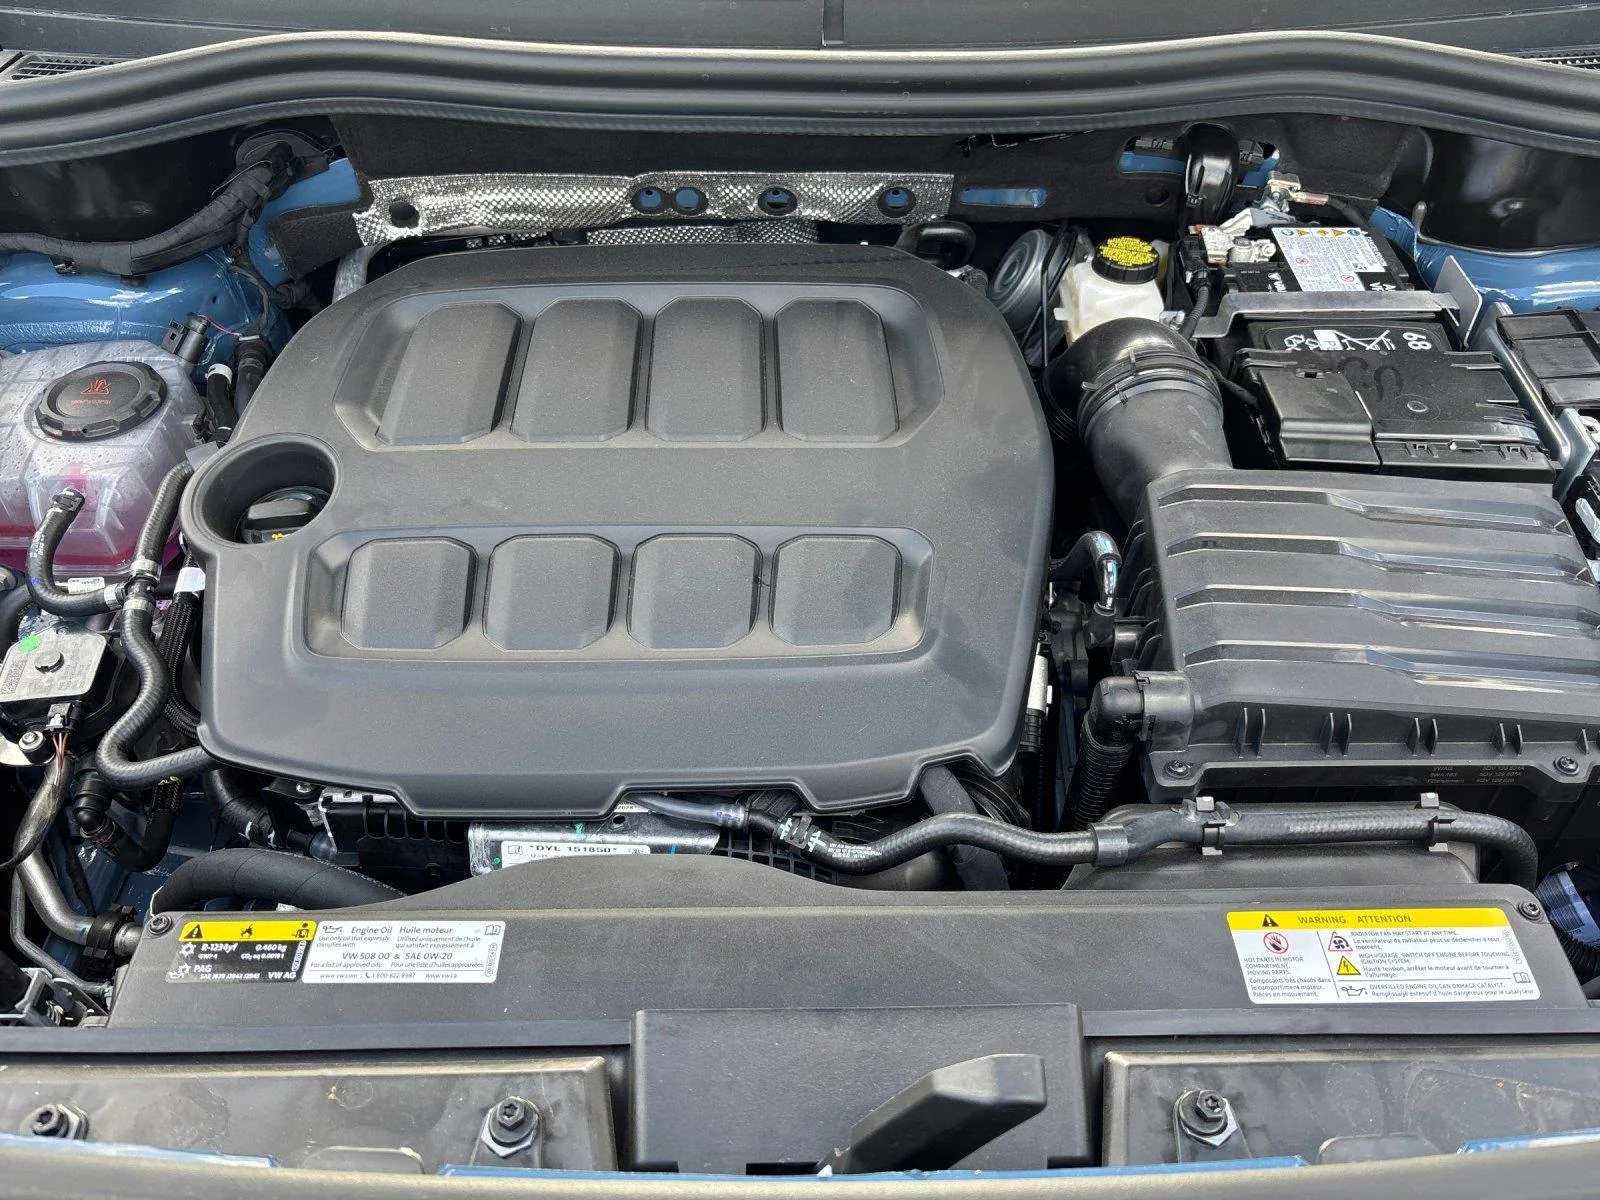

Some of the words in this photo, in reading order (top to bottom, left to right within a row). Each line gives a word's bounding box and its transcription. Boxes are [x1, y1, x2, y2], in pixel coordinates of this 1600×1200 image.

[1298, 916, 1347, 924] WARNING
[1357, 915, 1412, 923] ATTENTION
[351, 926, 379, 935] Engine
[380, 926, 392, 934] Oil
[400, 926, 421, 934] Huile
[422, 926, 453, 934] moteur
[201, 943, 238, 953] R-1234yf
[278, 944, 288, 952] kg
[342, 952, 358, 960] VW
[359, 952, 377, 960] 508
[378, 952, 391, 960] 00
[405, 952, 422, 960] SAE
[423, 952, 453, 960] 0W-20
[193, 964, 212, 972] PAG
